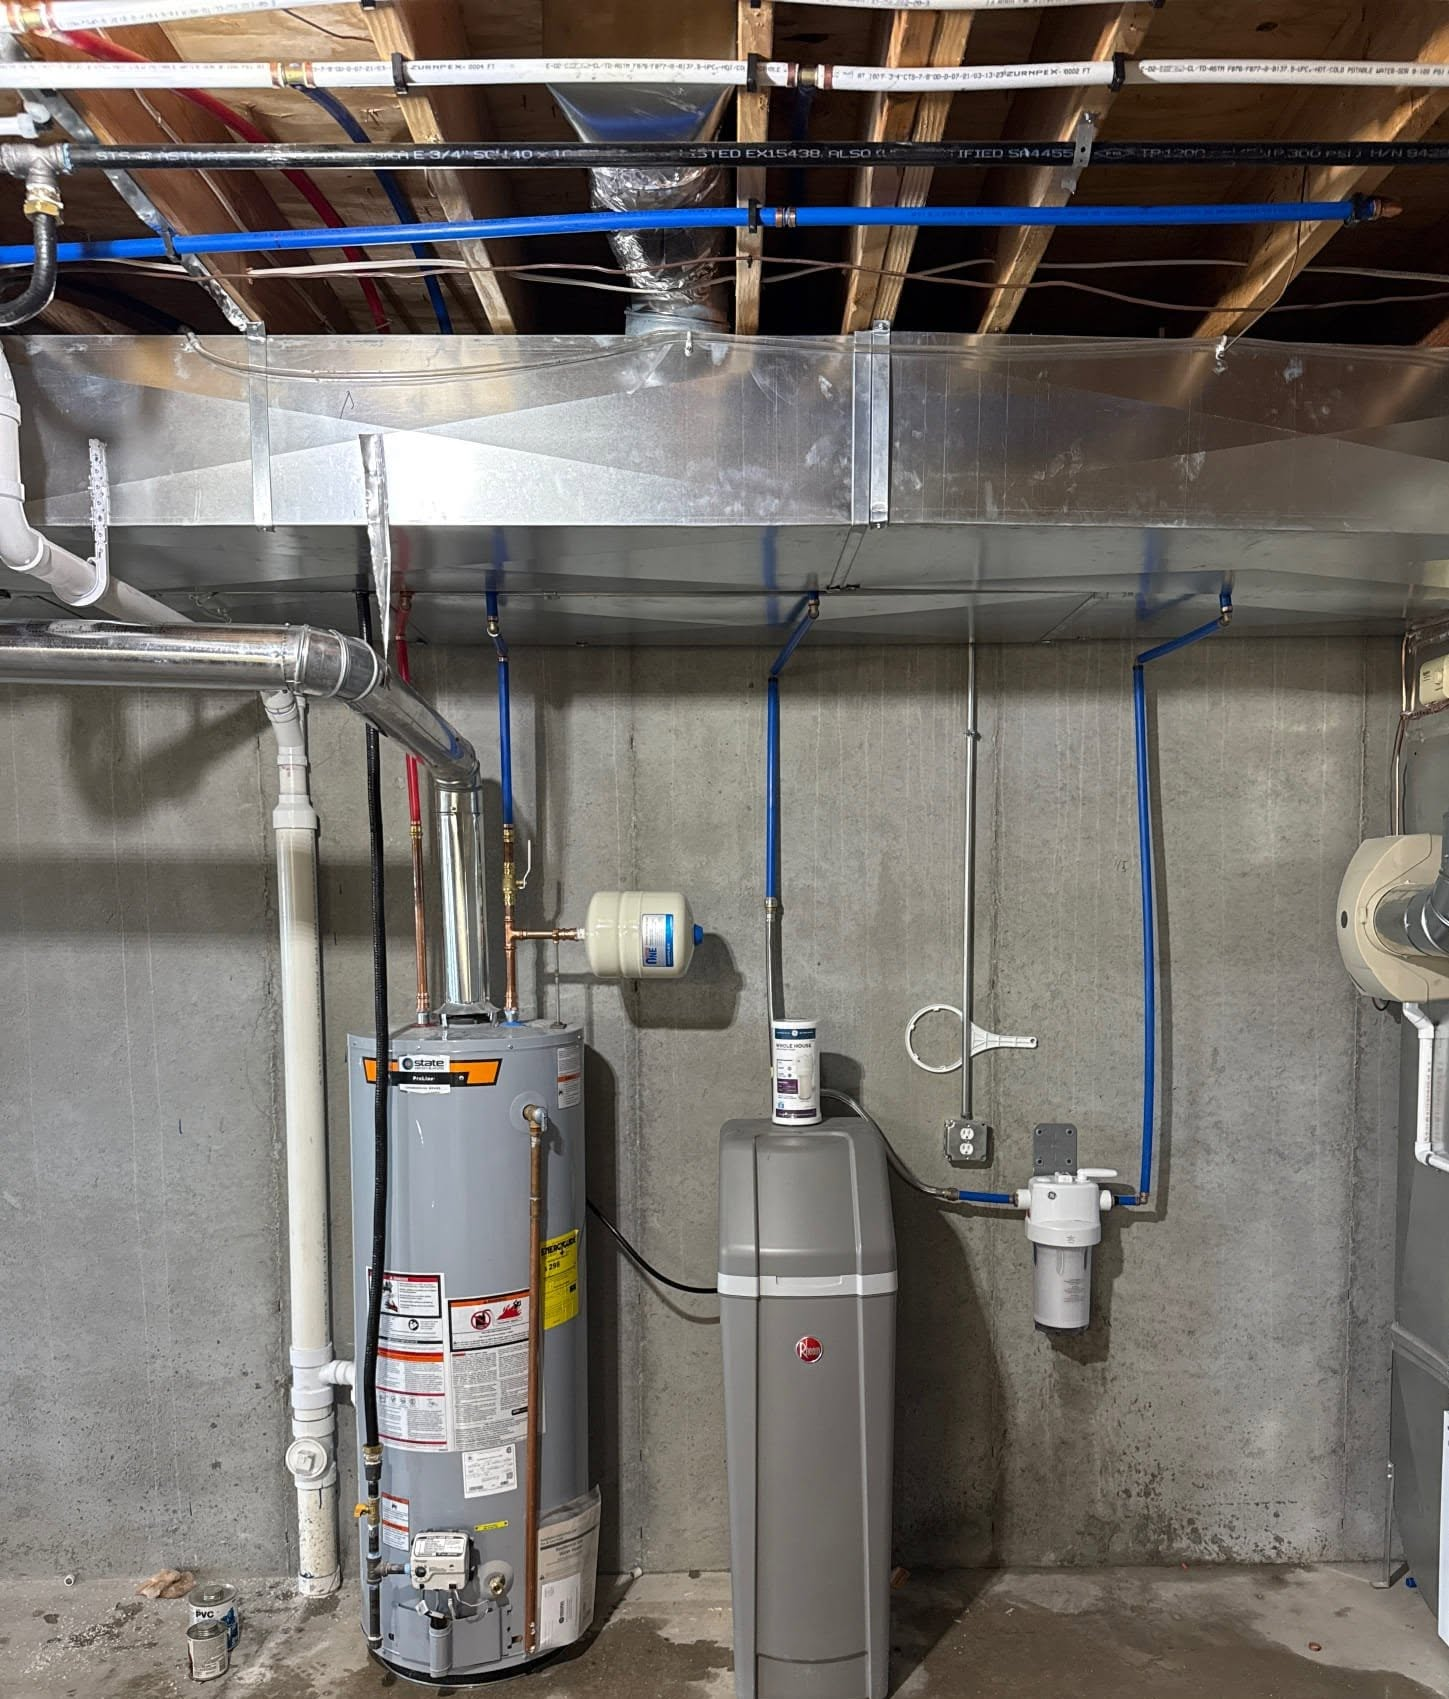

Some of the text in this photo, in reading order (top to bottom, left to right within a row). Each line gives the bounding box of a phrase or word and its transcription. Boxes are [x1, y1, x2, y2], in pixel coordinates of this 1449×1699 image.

[828, 149, 871, 159] ALSO
[414, 1059, 445, 1067] state
[195, 1610, 215, 1618] PVC
